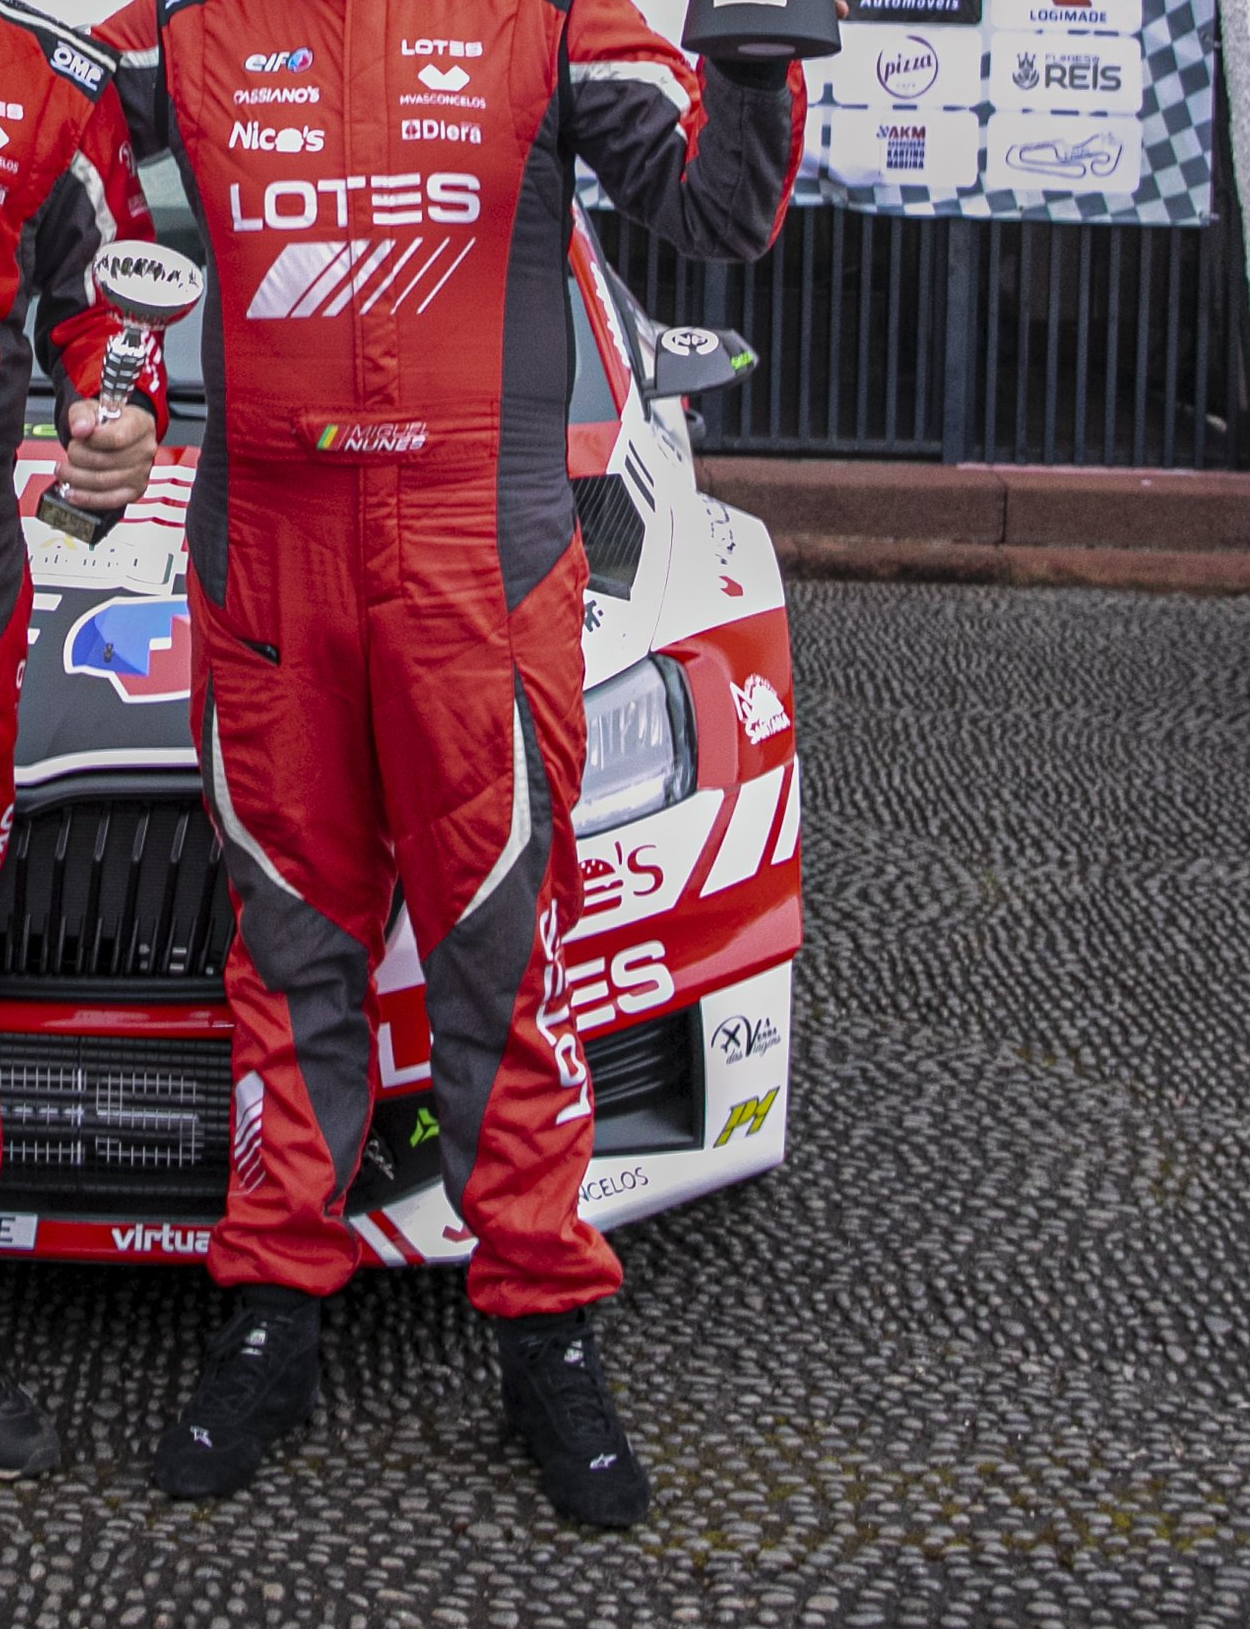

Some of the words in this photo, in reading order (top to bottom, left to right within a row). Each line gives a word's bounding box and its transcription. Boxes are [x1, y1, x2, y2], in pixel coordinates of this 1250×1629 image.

[1029, 9, 1107, 24] LOGIMADE
[51, 42, 103, 89] OMP
[884, 53, 933, 83] pizza
[1044, 63, 1122, 92] REIS
[888, 125, 927, 139] AKM
[229, 172, 482, 232] LOTES
[344, 435, 426, 452] NUNES
